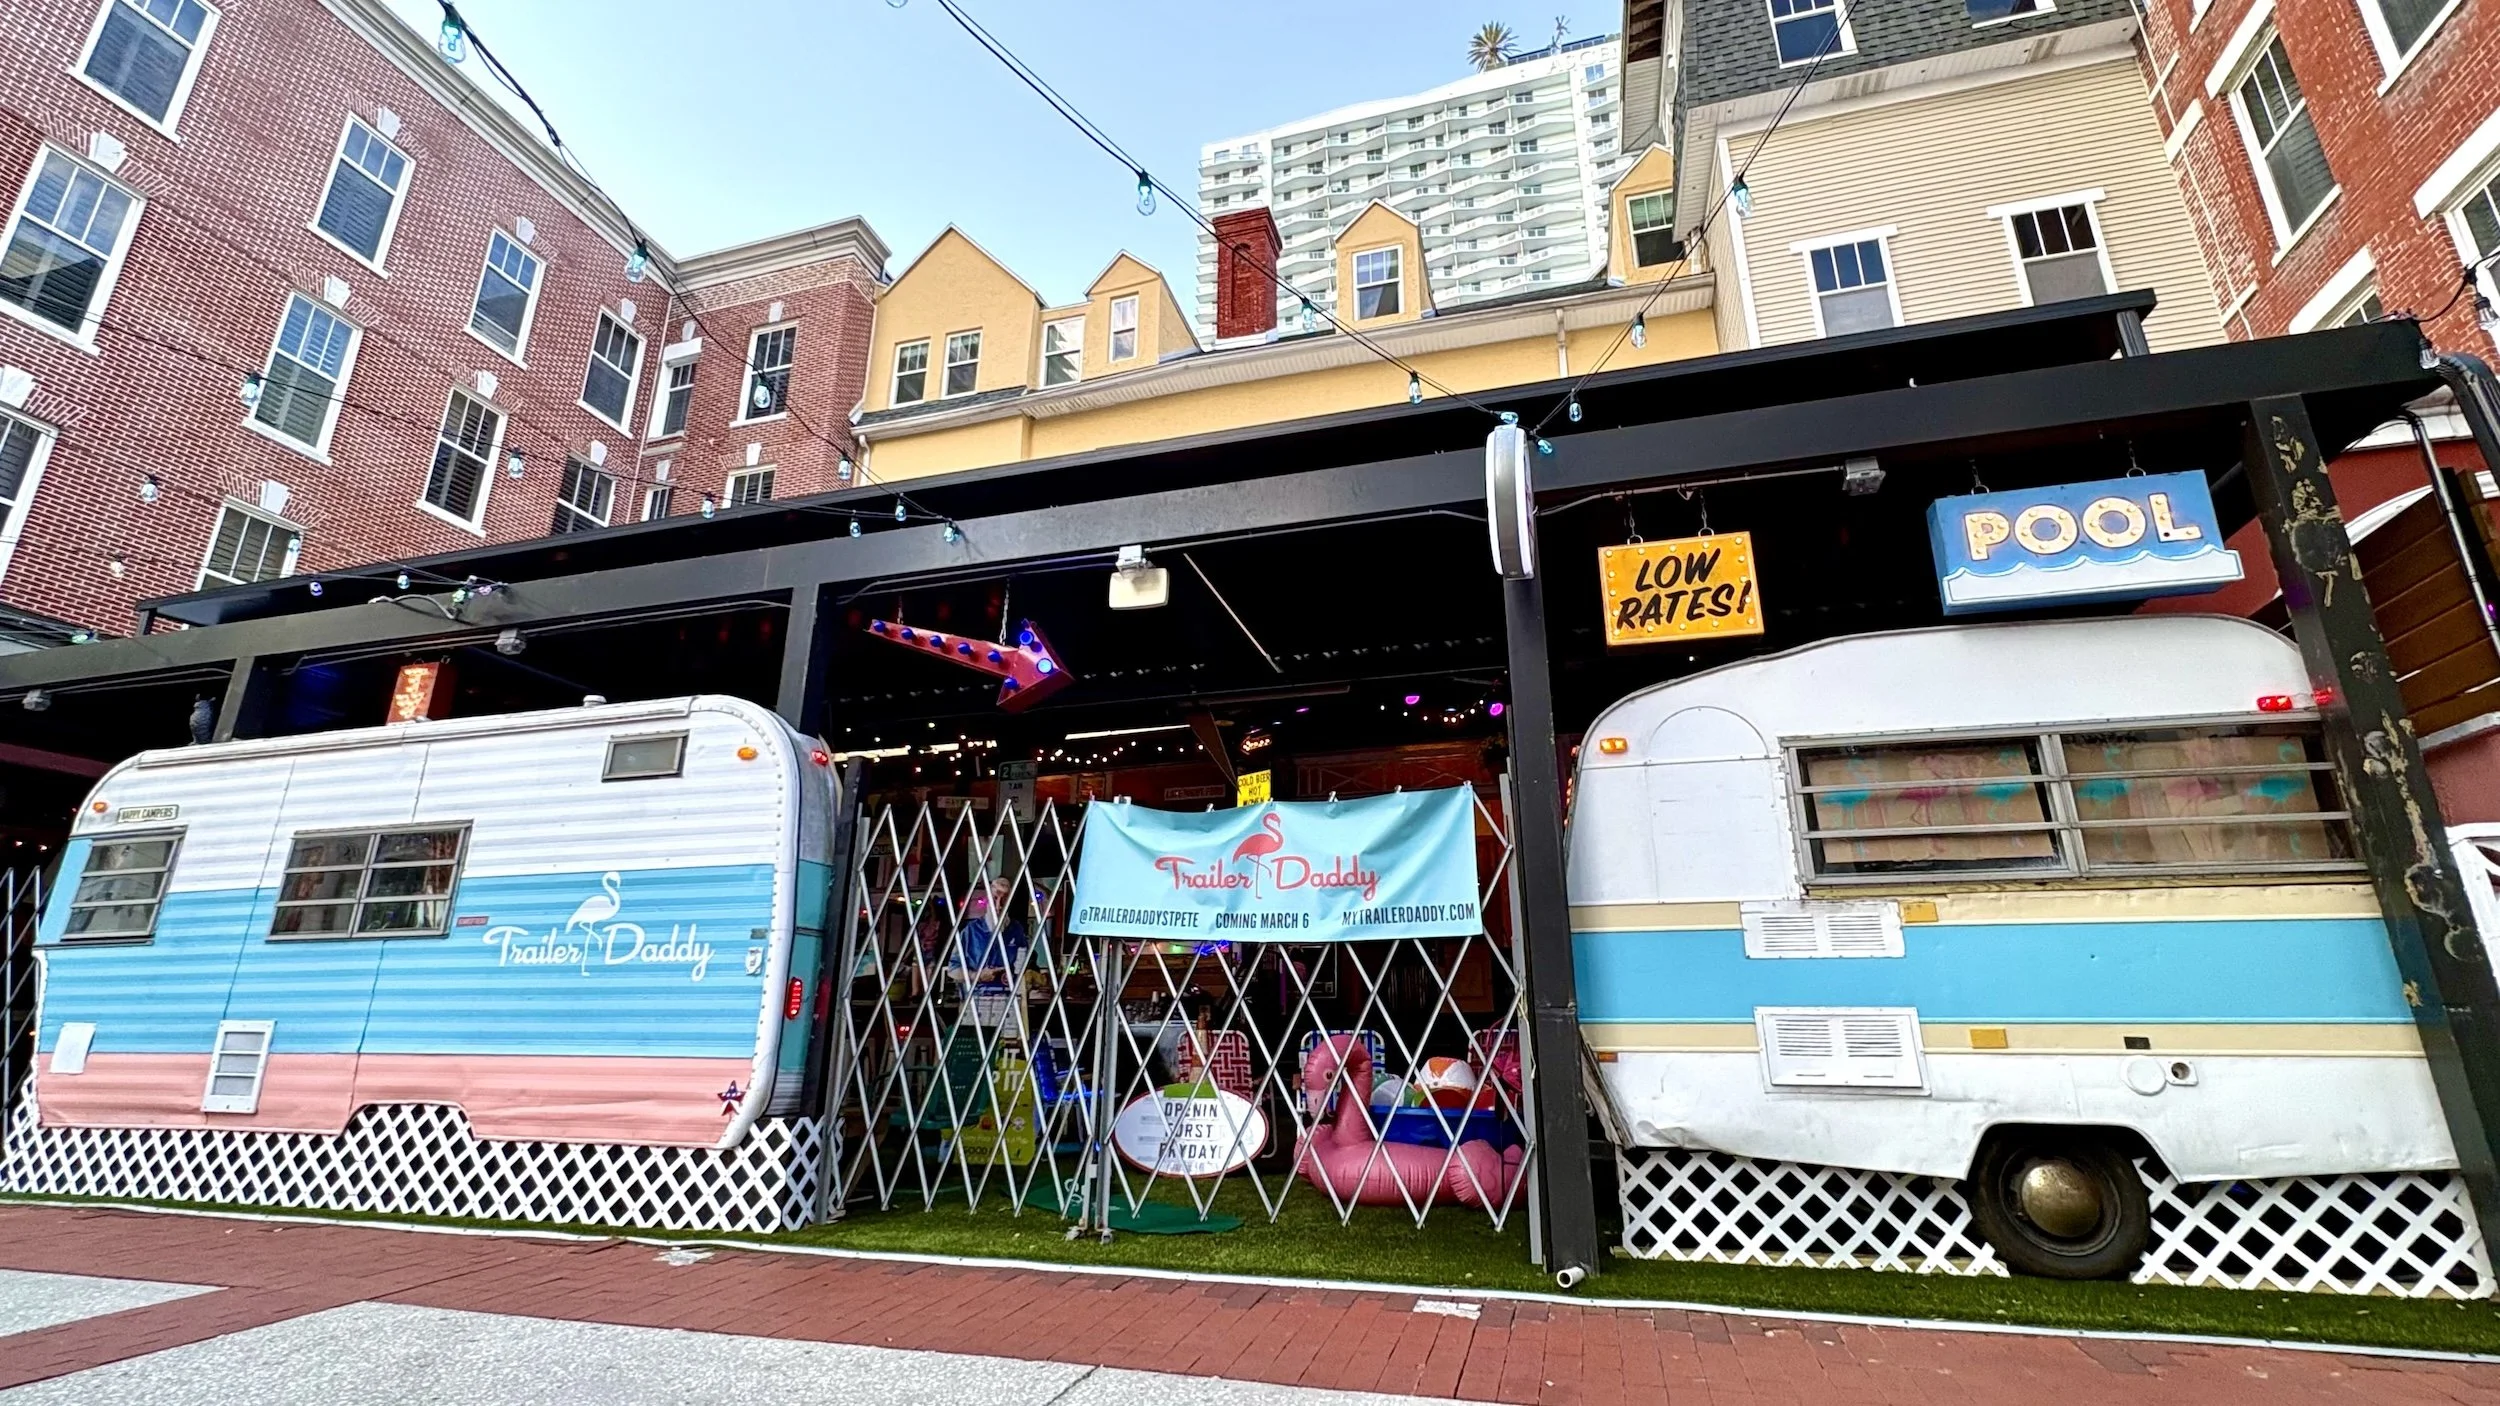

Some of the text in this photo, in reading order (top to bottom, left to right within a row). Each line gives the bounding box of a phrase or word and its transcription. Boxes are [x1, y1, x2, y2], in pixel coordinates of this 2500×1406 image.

[1964, 492, 2203, 561] POOL
[1635, 548, 1721, 592] LOW
[1616, 579, 1752, 630] RATES!
[1248, 784, 1261, 796] HOT
[121, 807, 174, 820] HAPPY CAMPERS
[1154, 855, 1380, 902] Trailer Daddy
[1079, 903, 1475, 929] @TRAILERDADDYSTPETE COMING MARCH 6 MYTRAILERDADDY.COM
[482, 925, 583, 967] Trailer
[602, 922, 716, 982] Daddy
